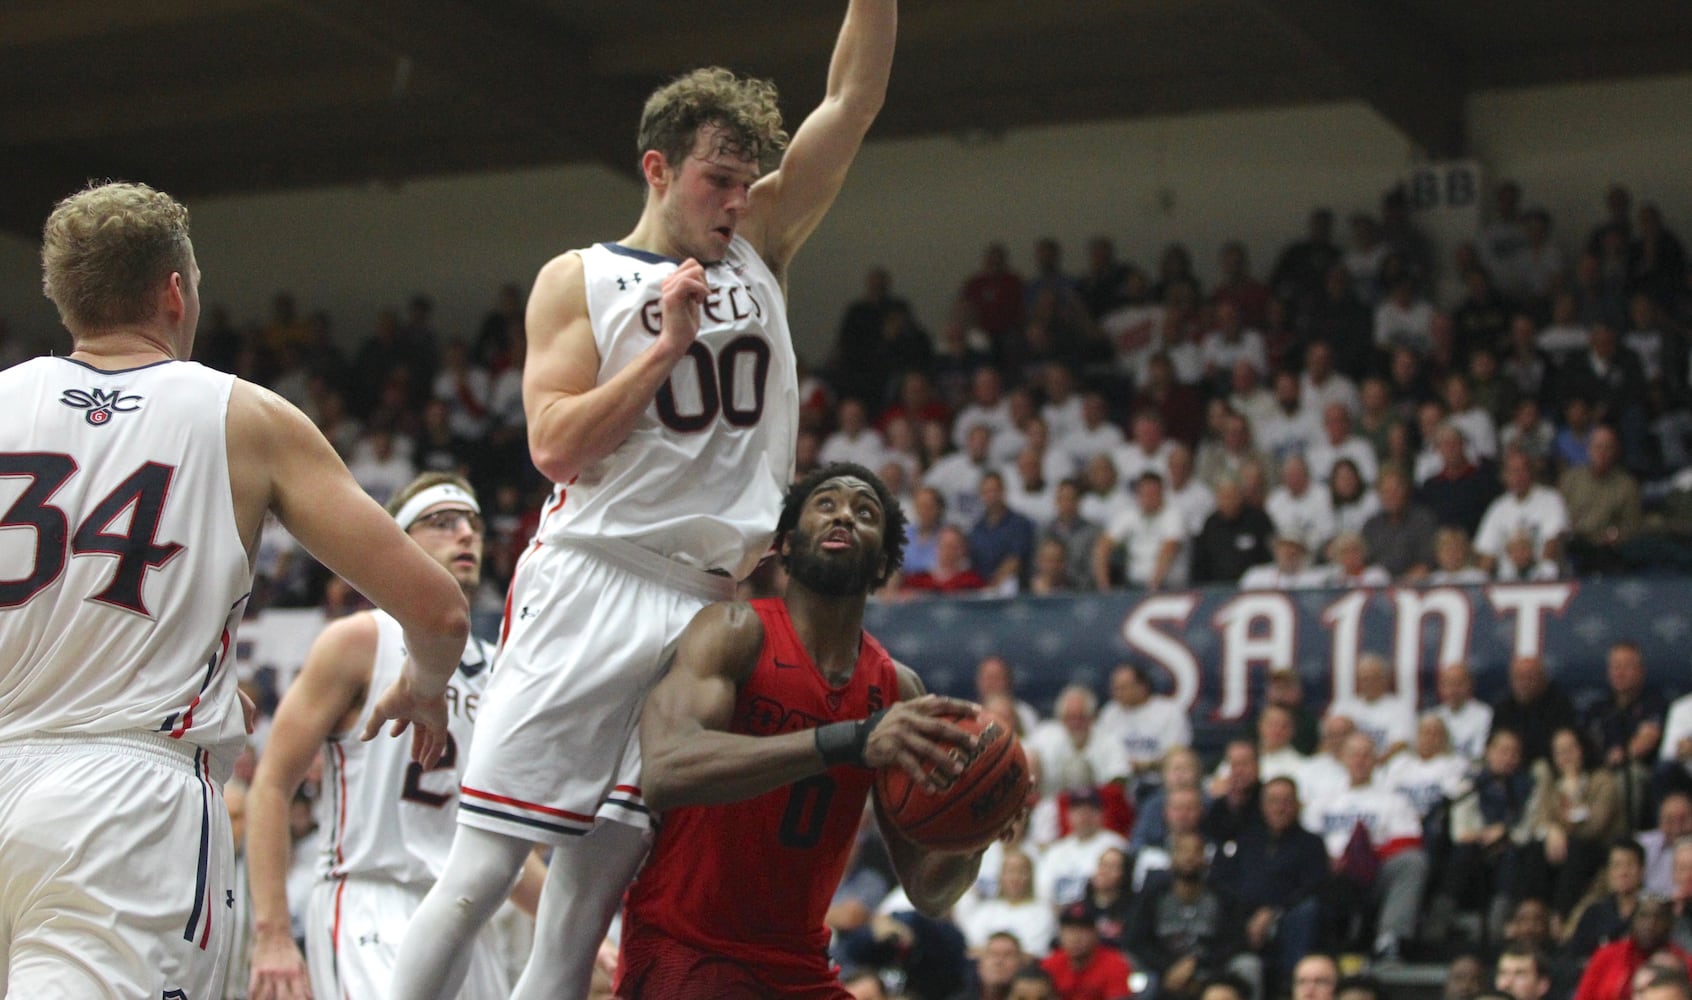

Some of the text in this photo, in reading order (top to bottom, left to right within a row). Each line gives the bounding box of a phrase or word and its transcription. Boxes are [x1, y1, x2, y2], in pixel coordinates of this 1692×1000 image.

[640, 284, 761, 336] GELS
[59, 388, 143, 411] SMC
[655, 334, 770, 433] 00
[0, 452, 186, 620] 34
[1122, 583, 1577, 720] SAINT
[401, 730, 462, 809] 2
[779, 774, 837, 850] 0
